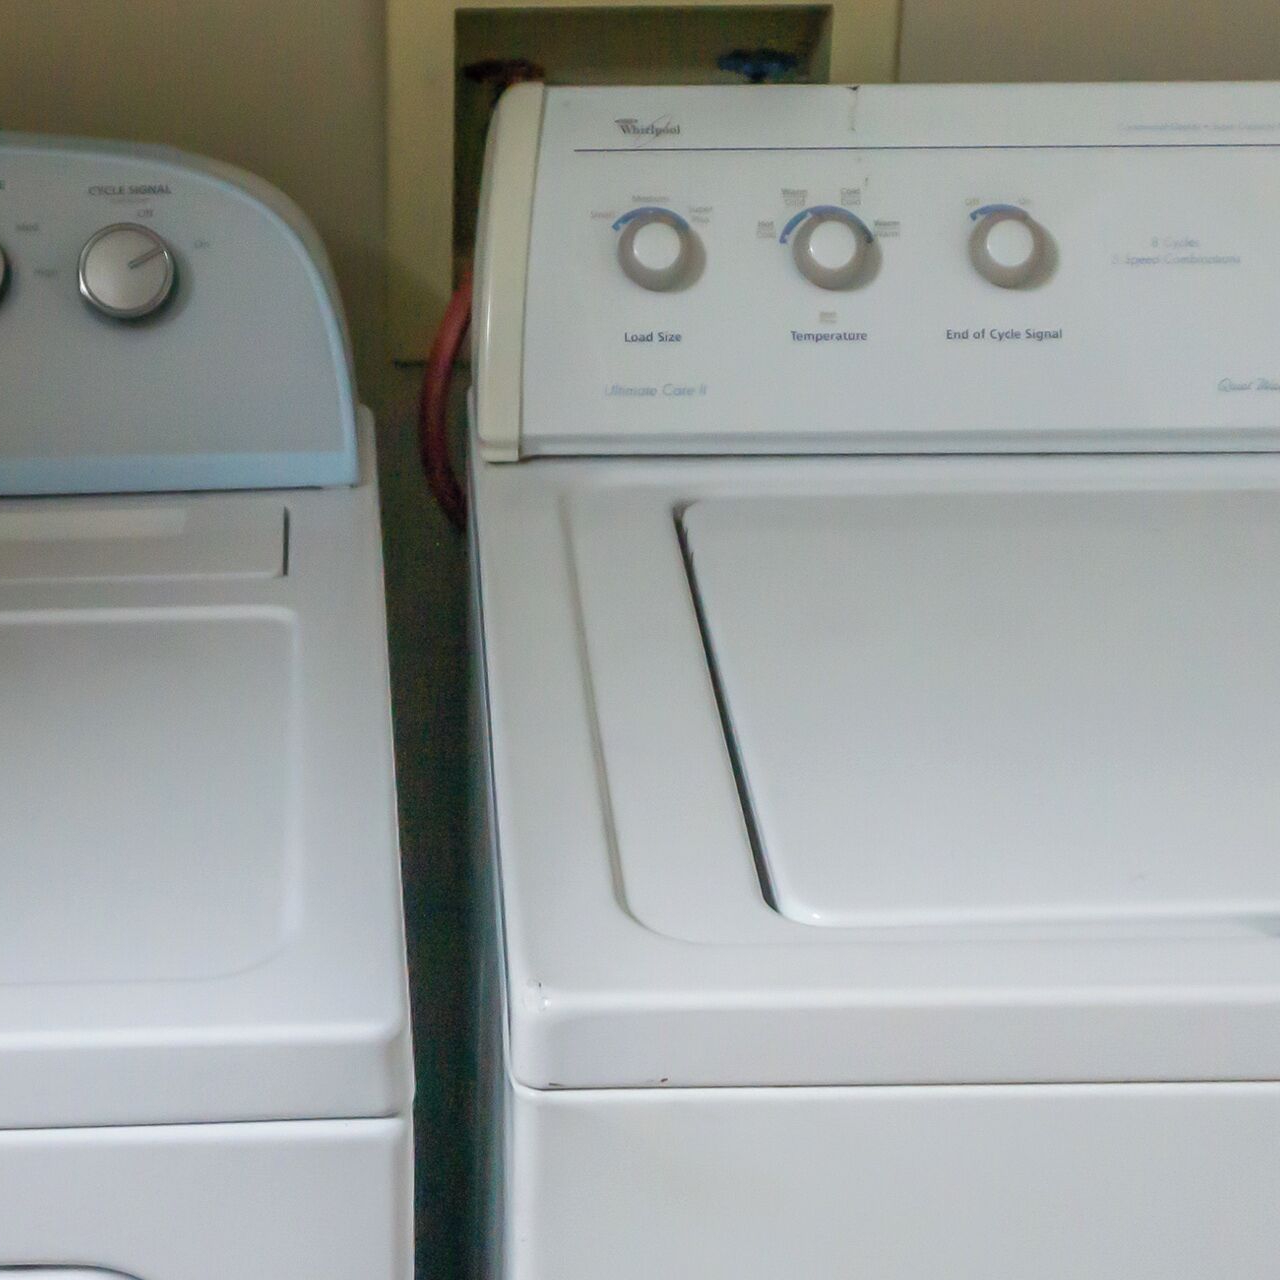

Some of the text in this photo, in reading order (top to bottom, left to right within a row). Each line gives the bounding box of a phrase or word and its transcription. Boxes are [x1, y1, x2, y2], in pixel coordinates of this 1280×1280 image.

[615, 114, 681, 141] Whirlpool
[88, 184, 172, 195] CYCLE SIGNAL
[624, 331, 682, 342] Load Size
[790, 331, 868, 343] Temperature
[946, 328, 1063, 342] End of Cycle Signal
